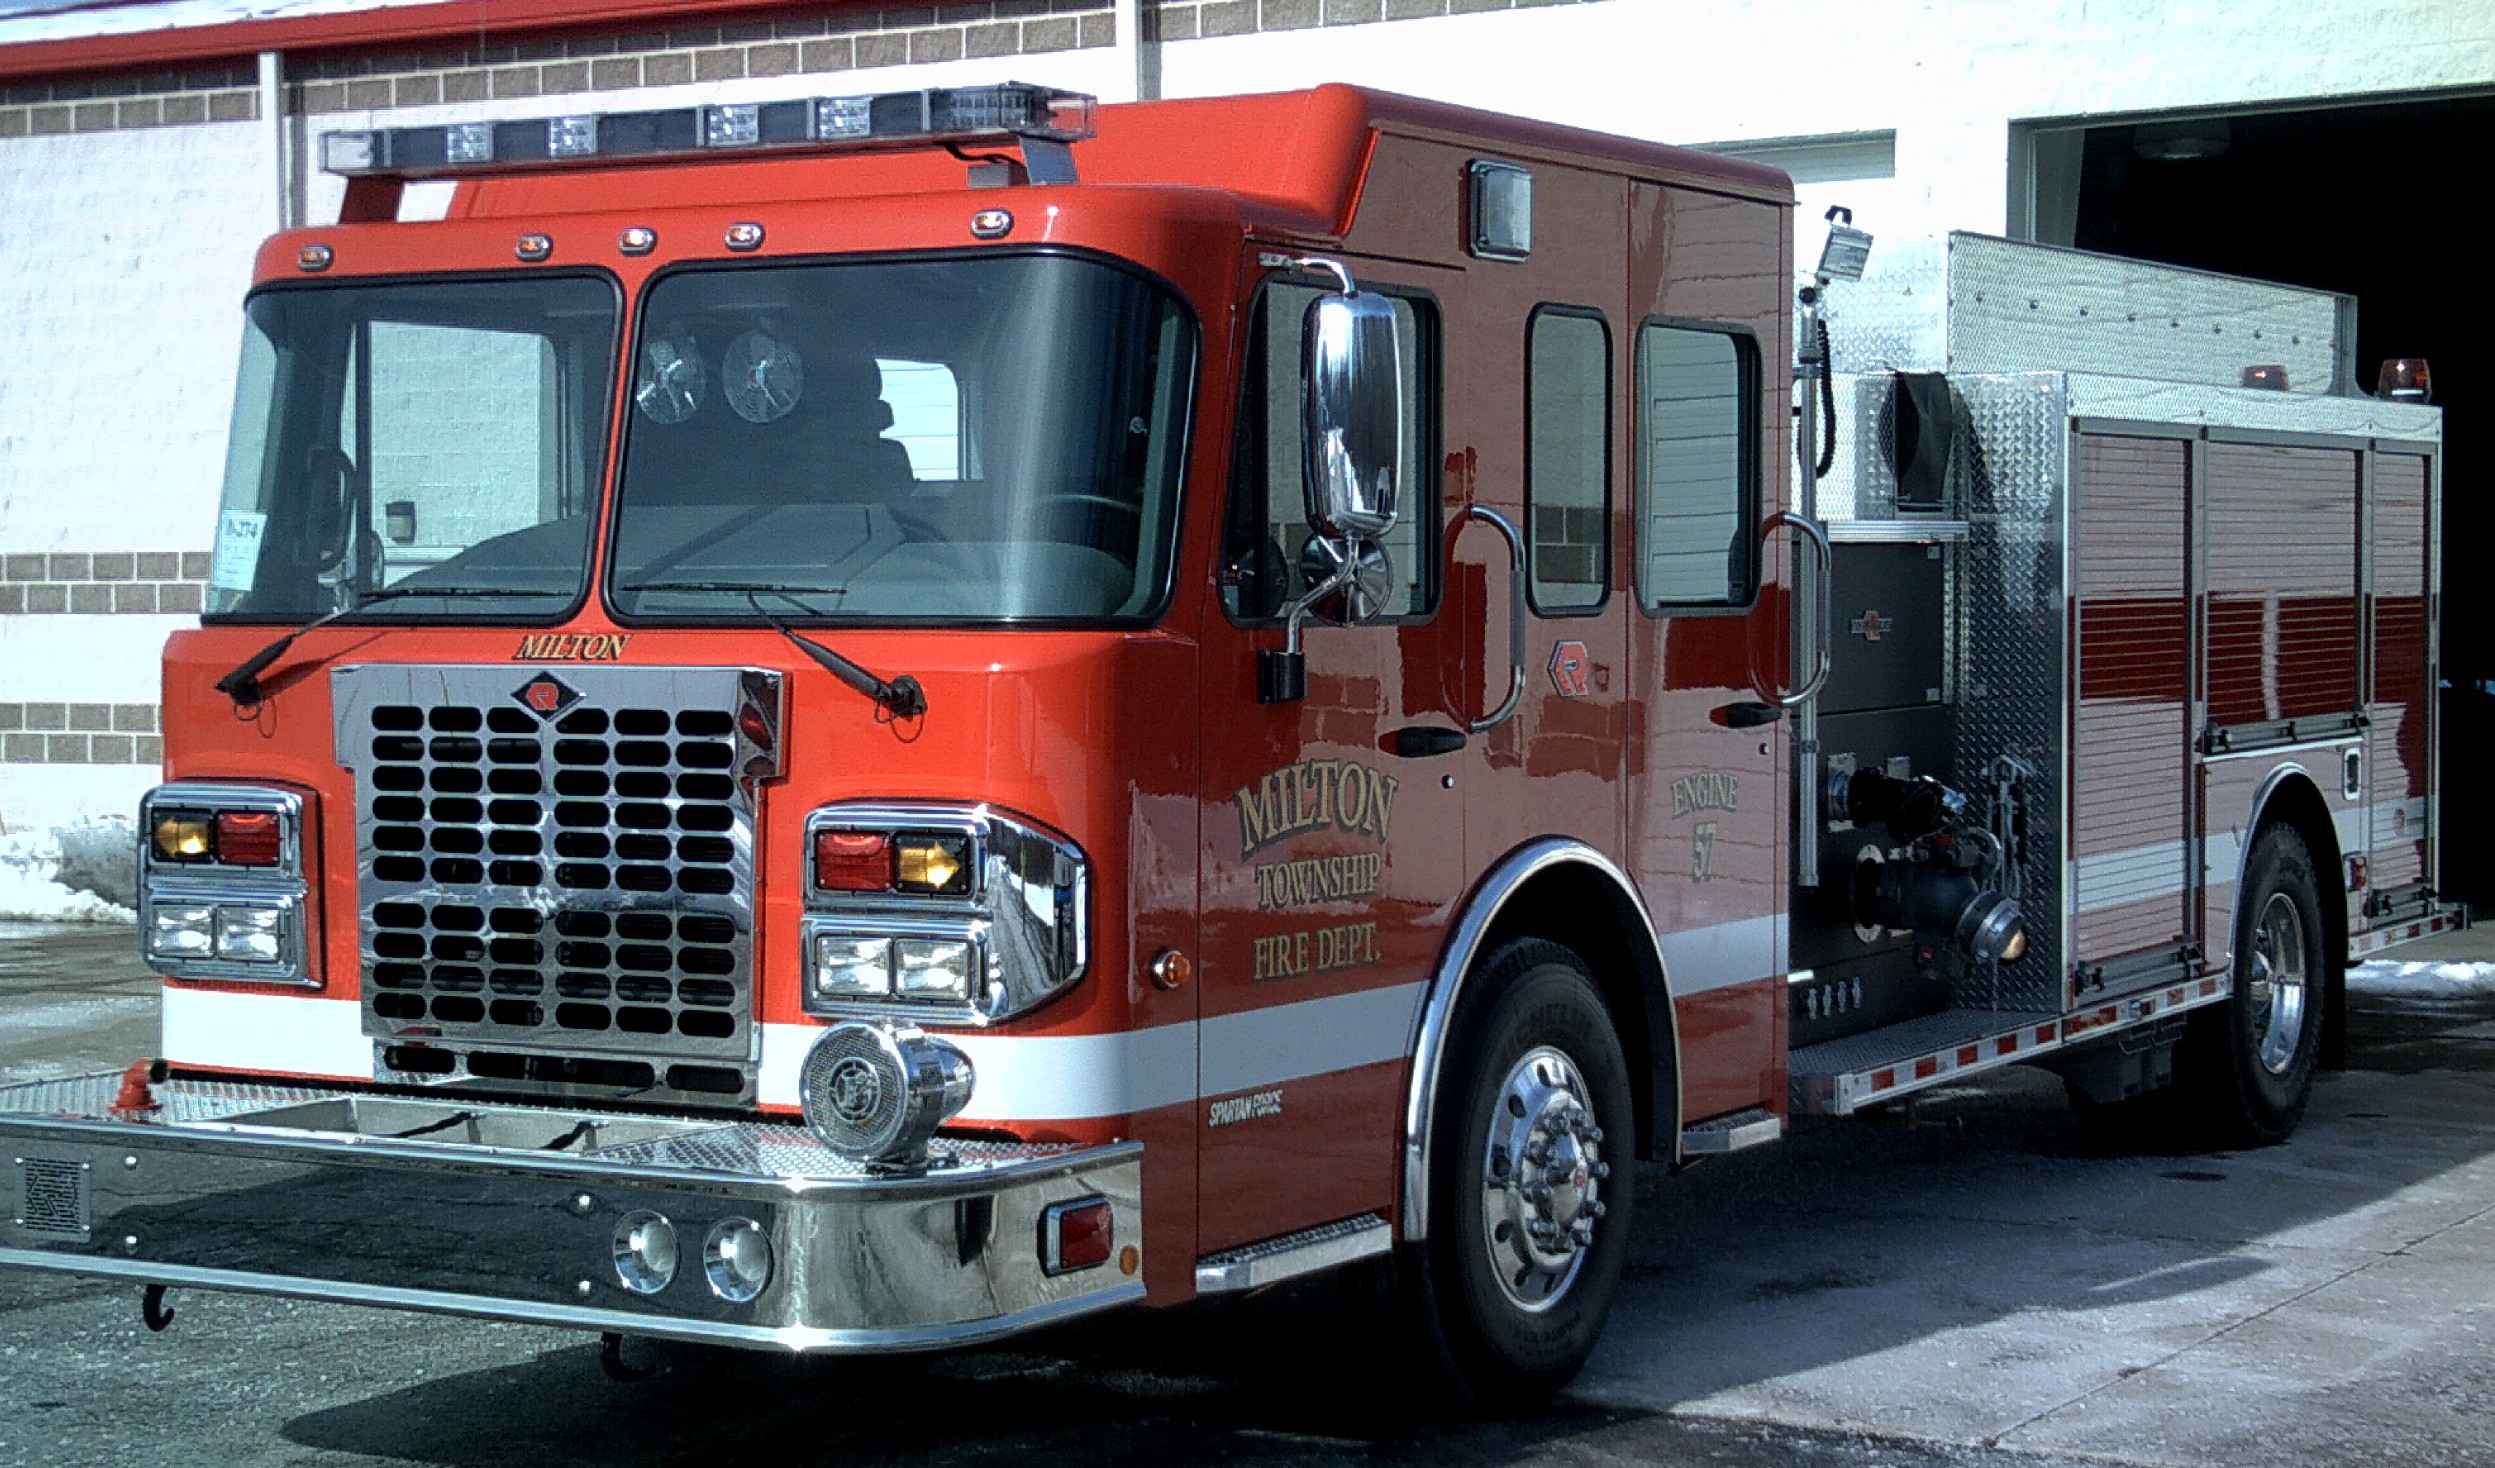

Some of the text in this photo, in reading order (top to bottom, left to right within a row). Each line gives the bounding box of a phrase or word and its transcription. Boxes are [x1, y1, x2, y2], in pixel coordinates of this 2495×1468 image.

[513, 634, 632, 660] MILTON
[1236, 759, 1398, 856] MILTON
[1671, 773, 1738, 819] ENGINE
[1255, 853, 1381, 907] TOWNSHIP
[1253, 922, 1382, 982] FIRE DEPT.
[1209, 1096, 1252, 1127] SPARTAN
